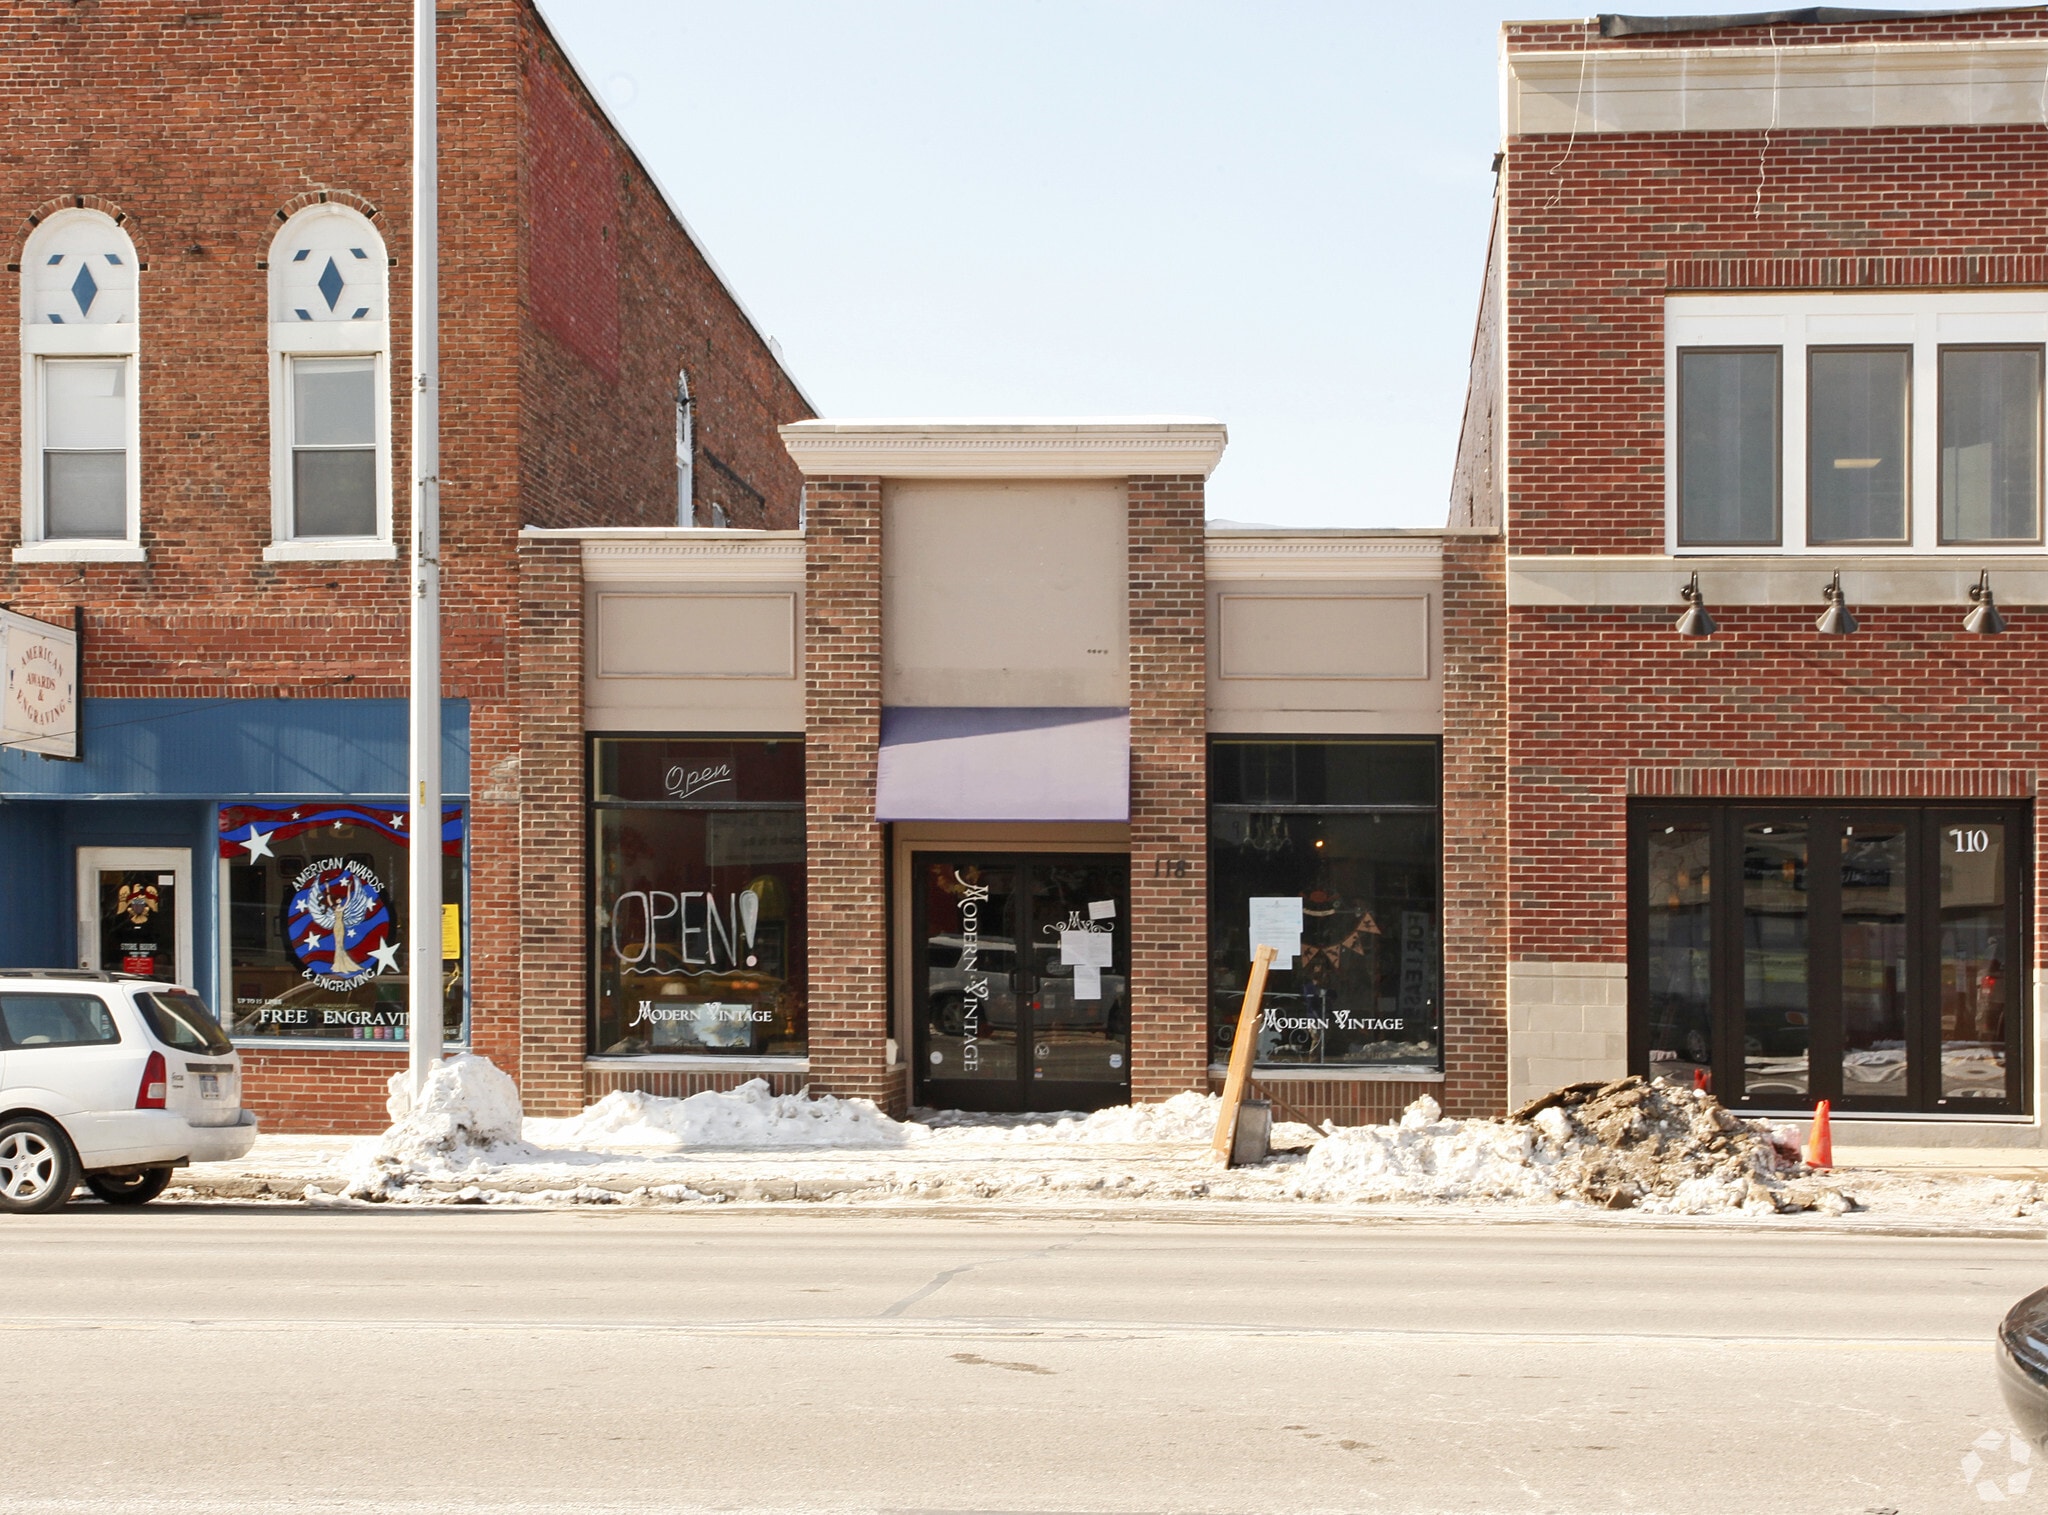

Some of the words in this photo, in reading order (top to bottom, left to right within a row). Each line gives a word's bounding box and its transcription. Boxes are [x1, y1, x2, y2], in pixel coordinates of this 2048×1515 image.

[21, 645, 64, 677] AMERICAN
[26, 672, 56, 691] AWARDS
[17, 688, 66, 725] ENGRAVING
[37, 688, 44, 702] &
[665, 763, 731, 794] Open
[1954, 829, 1989, 853] 110
[291, 857, 343, 892] AMERICAN
[345, 860, 385, 893] AWARDS
[1154, 859, 1186, 879] 118
[611, 889, 760, 967] OPEN!
[301, 968, 313, 980] &
[313, 968, 375, 992] ENGRAVING
[260, 1009, 309, 1024] FREE
[322, 1010, 410, 1026] ENGRAVI
